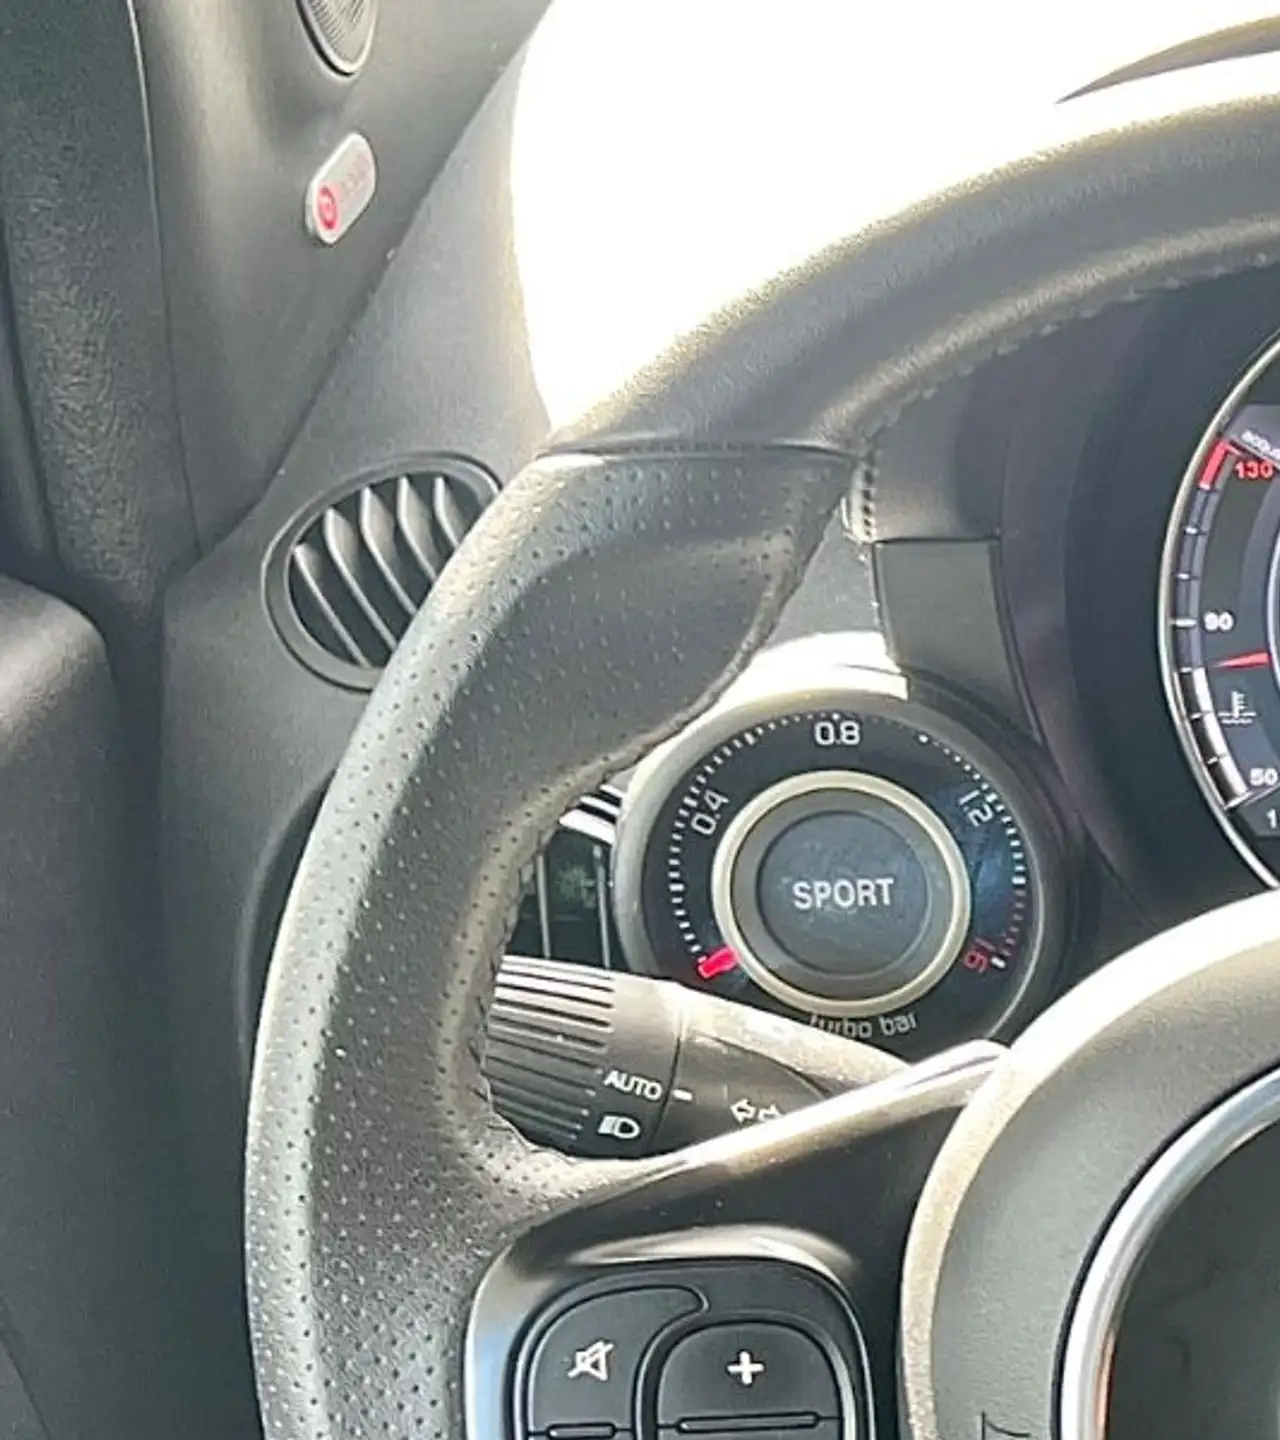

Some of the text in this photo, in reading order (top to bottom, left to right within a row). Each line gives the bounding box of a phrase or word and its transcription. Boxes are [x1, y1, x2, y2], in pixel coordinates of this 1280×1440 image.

[1234, 461, 1274, 479] 130
[1204, 611, 1233, 632] 90
[814, 721, 861, 747] 0.8
[1250, 768, 1279, 787] 50
[692, 789, 730, 837] 0.4
[958, 789, 994, 828] 1.2
[792, 877, 895, 910] SPORT
[878, 1010, 918, 1037] bar
[604, 1068, 663, 1101] AUTO
